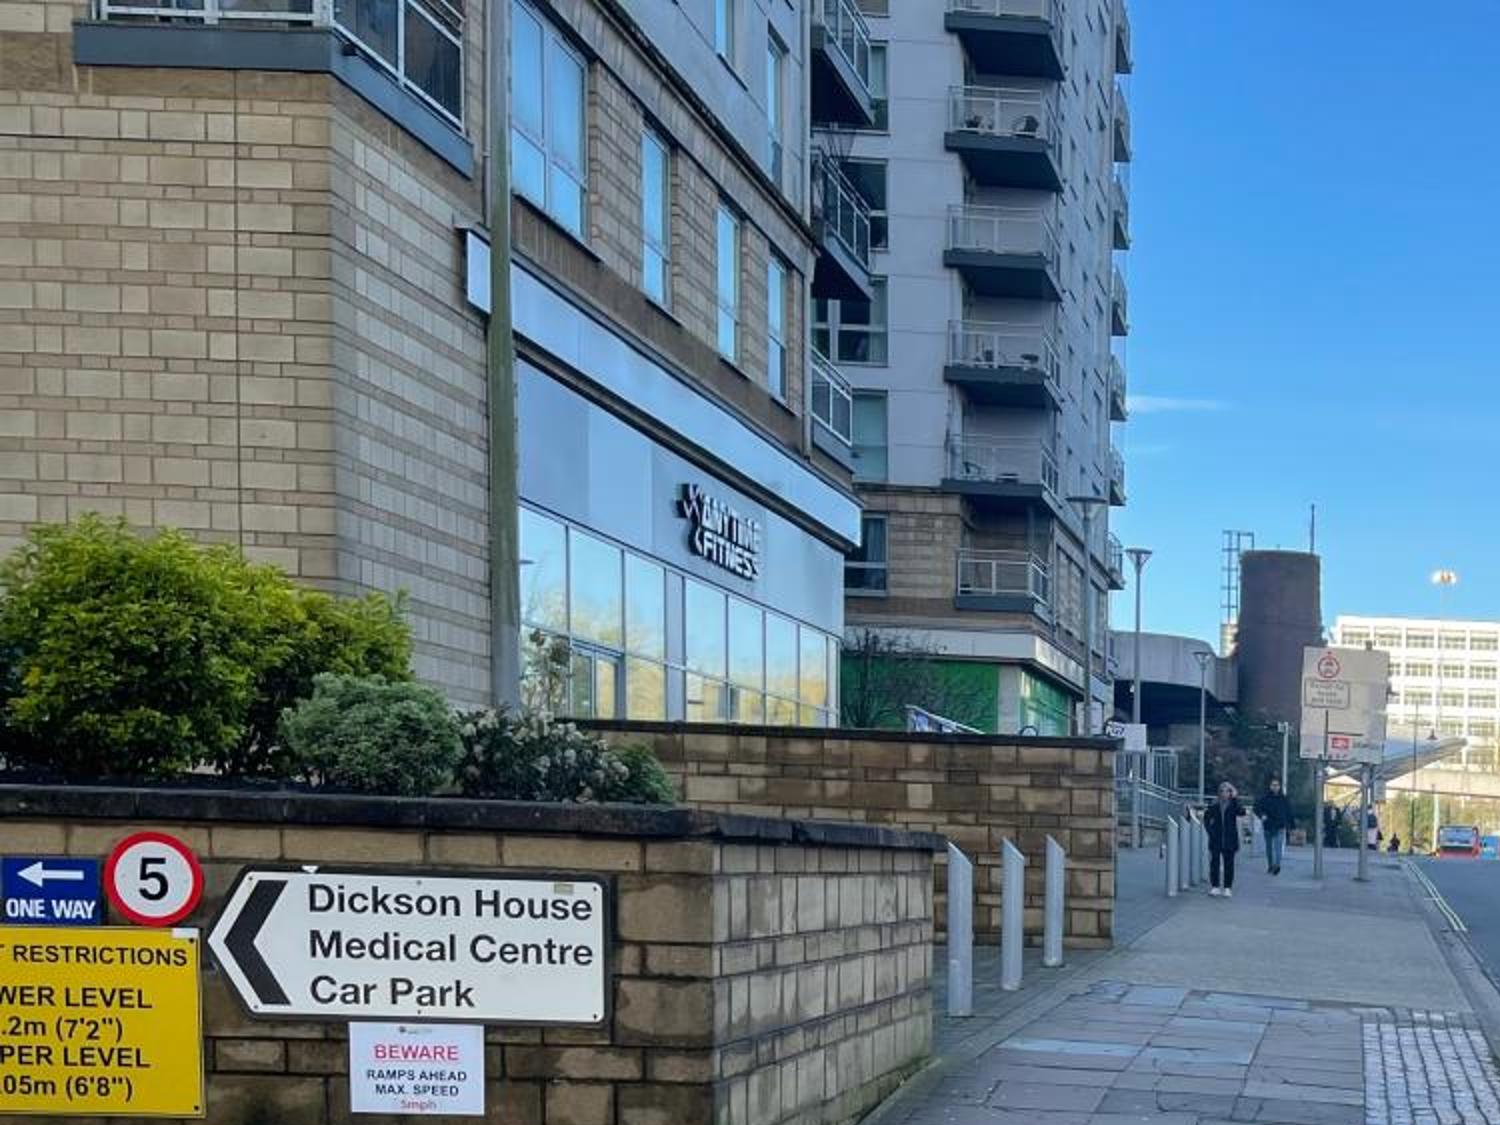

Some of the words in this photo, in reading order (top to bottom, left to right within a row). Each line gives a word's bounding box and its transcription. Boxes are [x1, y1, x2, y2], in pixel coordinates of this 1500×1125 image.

[702, 496, 761, 554] ANYTIME
[703, 530, 761, 580] FITNESS
[138, 856, 169, 902] 5
[6, 898, 46, 919] ONE
[52, 899, 97, 920] WAY
[308, 883, 461, 917] Dickson
[475, 889, 593, 921] House
[13, 944, 187, 967] RESTRICTIONS
[308, 929, 456, 963] Medical
[470, 934, 593, 967] Centre
[65, 987, 153, 1009] LEVEL
[310, 974, 377, 1007] Car
[389, 977, 476, 1009] Park
[55, 1016, 123, 1042] (7'2")
[63, 1047, 151, 1068] LEVEL
[373, 1044, 460, 1061] BEWARE
[366, 1069, 415, 1081] RAMPS
[419, 1070, 467, 1082] AHEAD
[66, 1076, 134, 1102] (6'8")
[412, 1084, 459, 1097] SPEED
